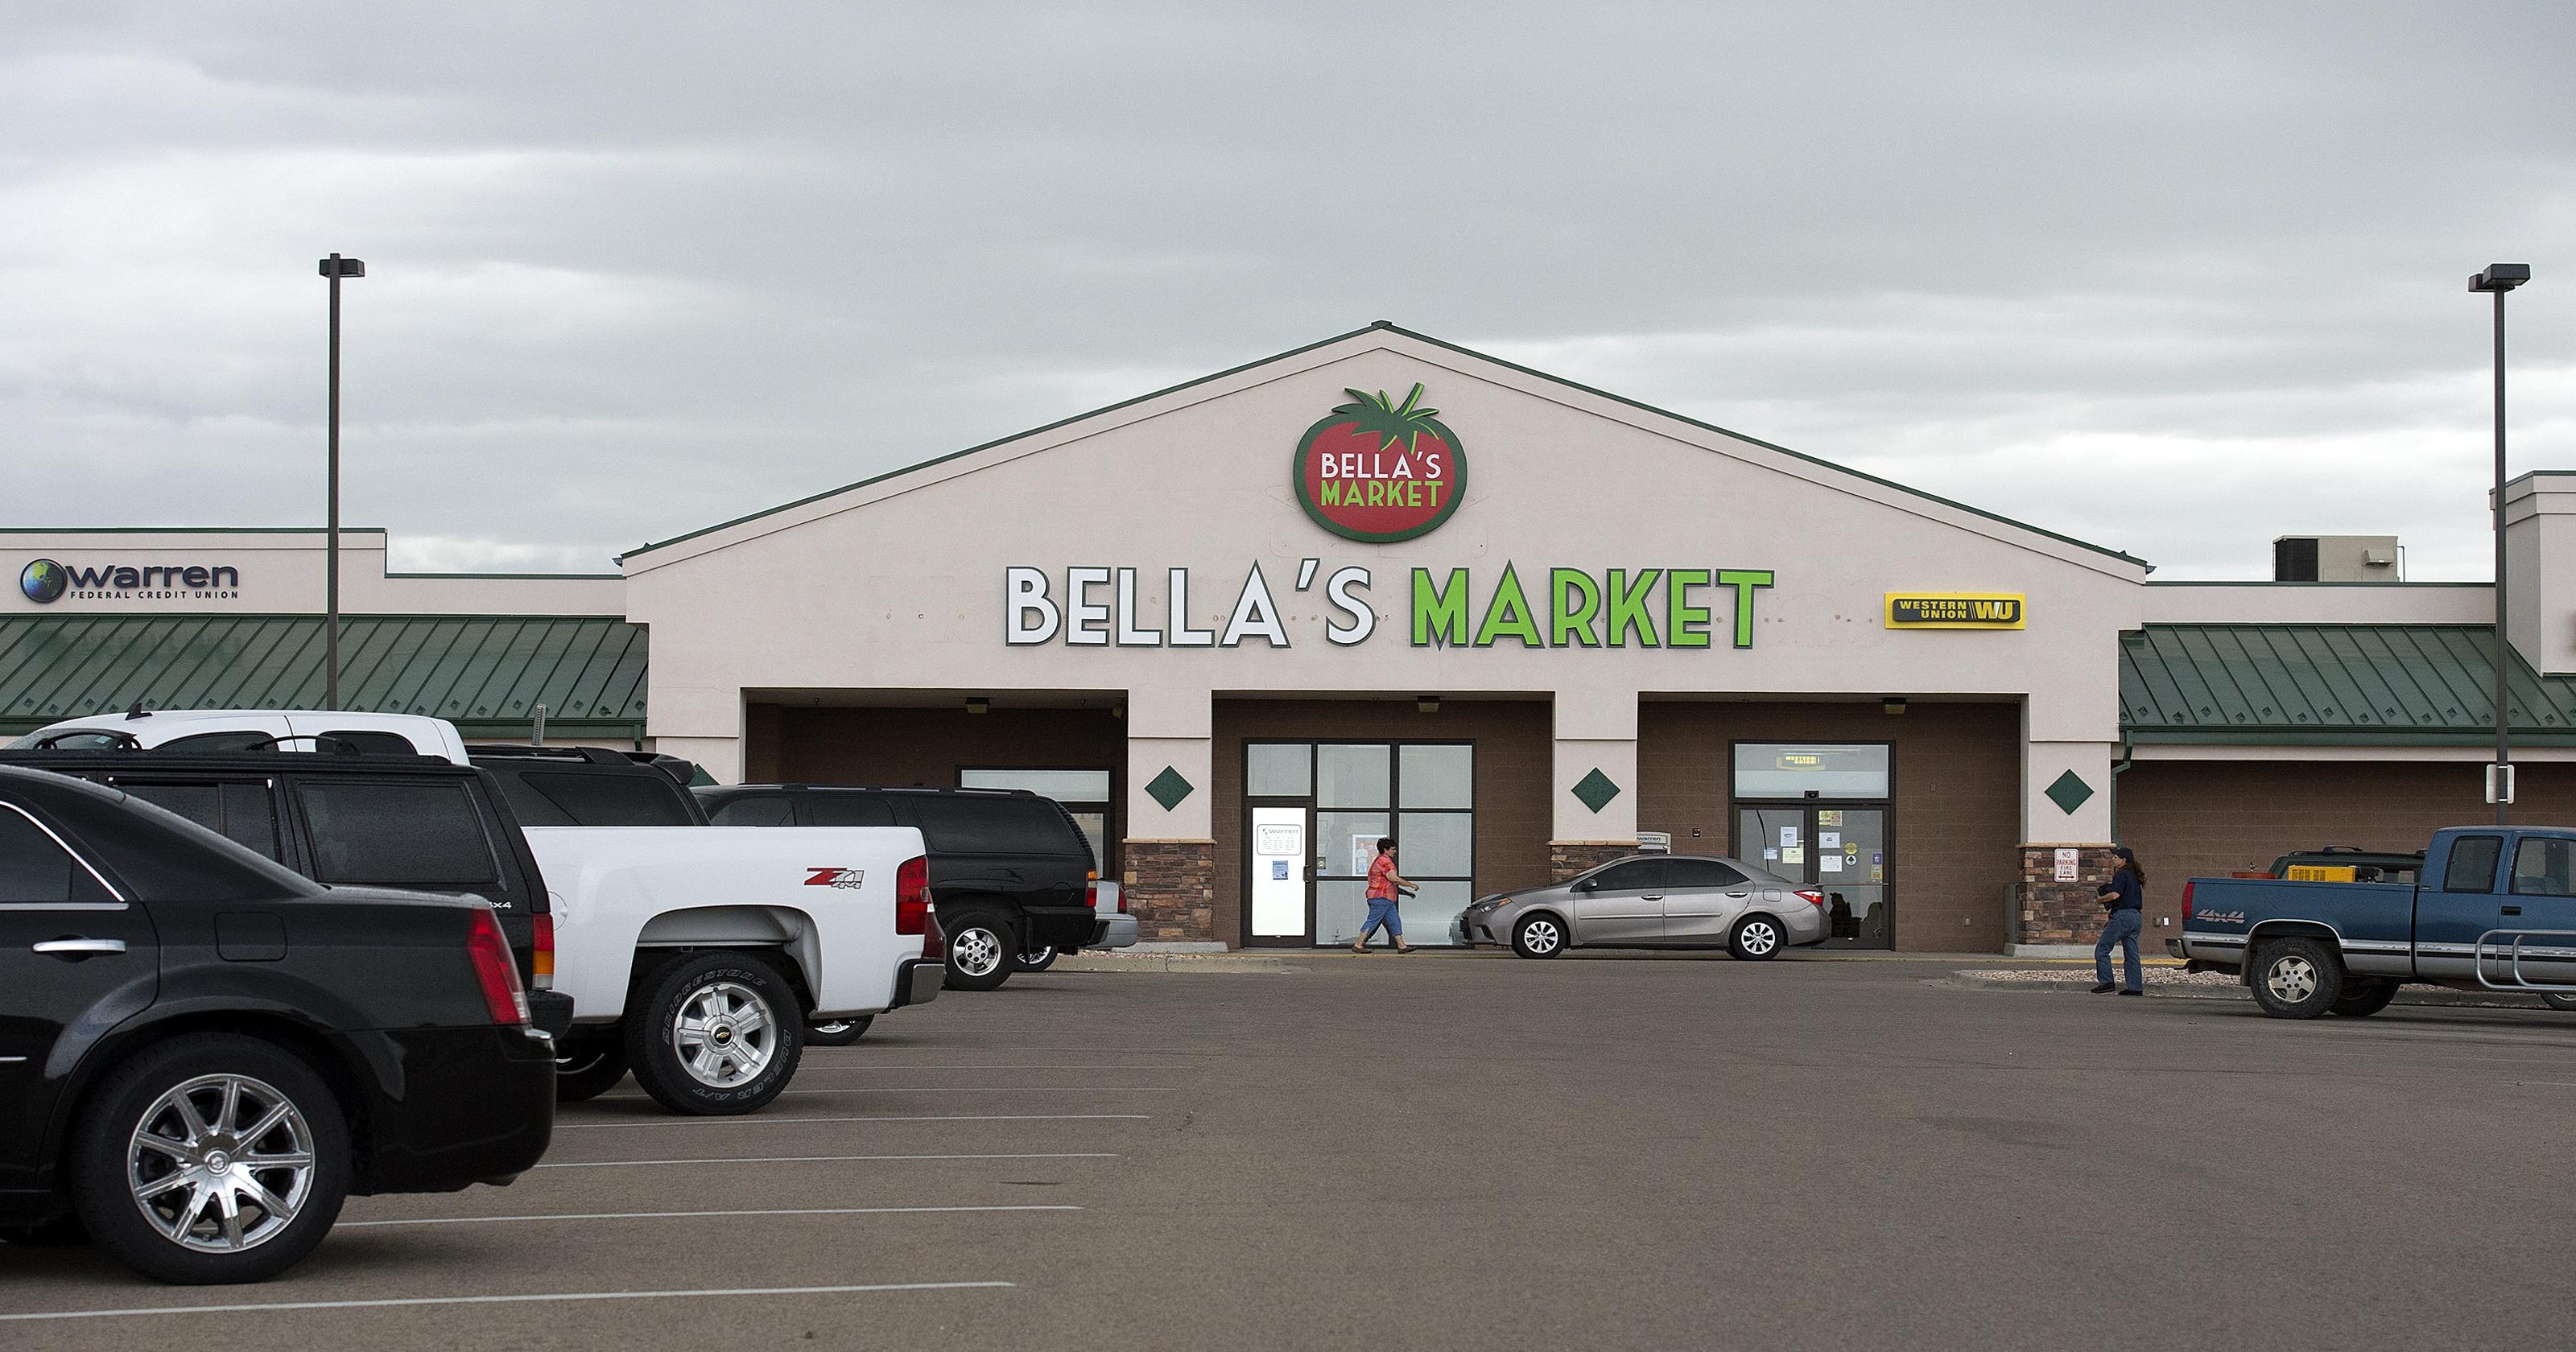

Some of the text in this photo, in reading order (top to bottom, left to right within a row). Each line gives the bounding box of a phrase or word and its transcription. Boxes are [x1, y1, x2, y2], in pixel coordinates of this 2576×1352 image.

[1320, 451, 1442, 479] BELLA'S
[1320, 480, 1443, 507] MARKET
[70, 591, 239, 599] FEDERAL CREDIT UNION
[1004, 557, 1377, 649] BELLA'S
[1410, 559, 1777, 650] MARKET
[1900, 601, 1967, 609] WESTERN
[1921, 610, 1967, 619] UNION
[804, 868, 865, 886] Z71
[662, 968, 767, 1045] BRIDGESTONE
[737, 1028, 793, 1100] DUELER
